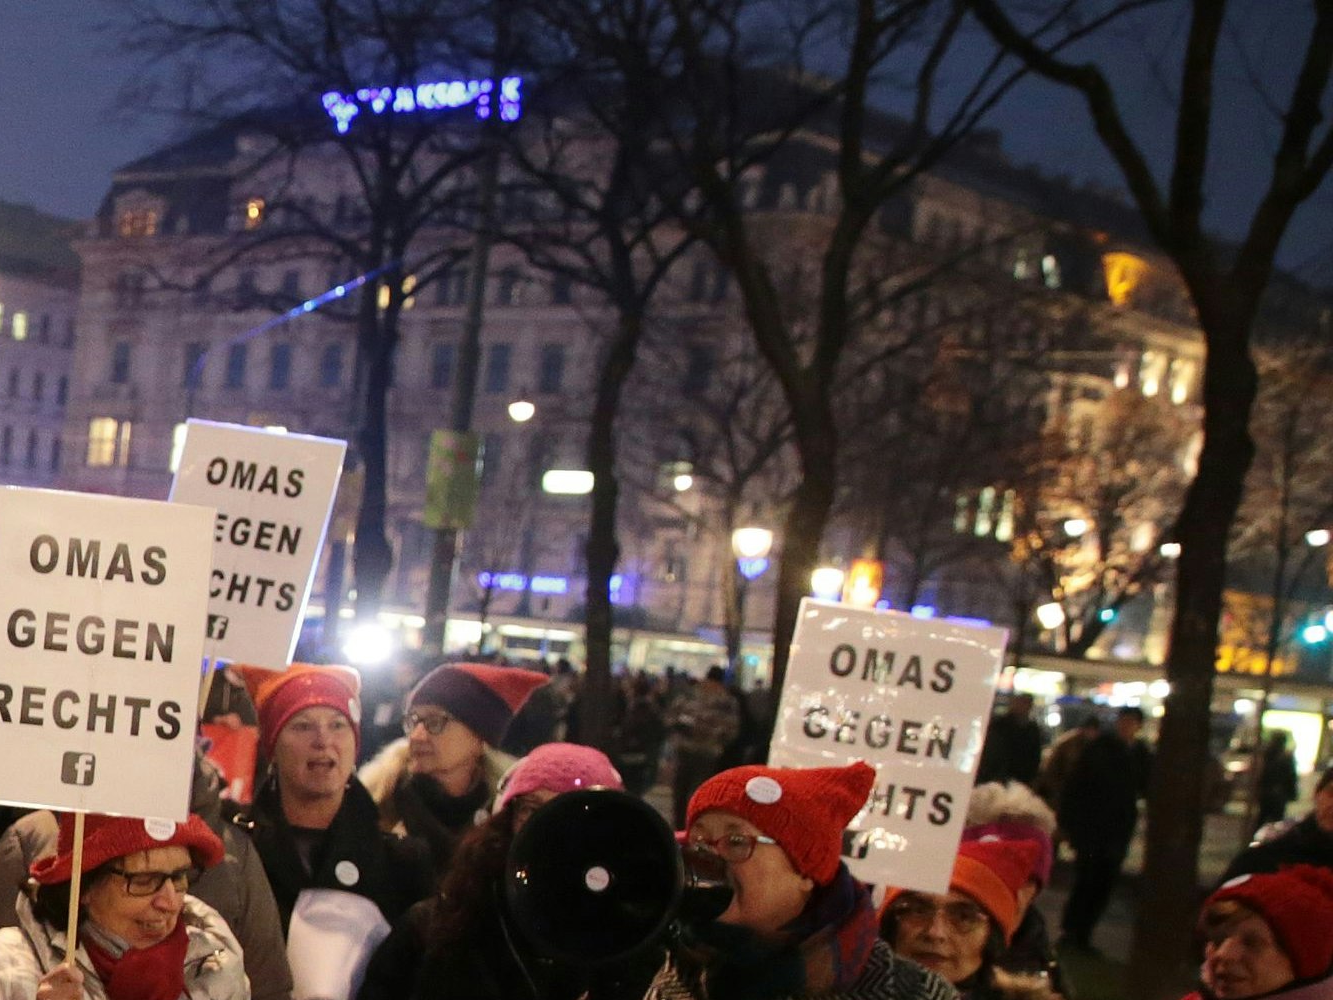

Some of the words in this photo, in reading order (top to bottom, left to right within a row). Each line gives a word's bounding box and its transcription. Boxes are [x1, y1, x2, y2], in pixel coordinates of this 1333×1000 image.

[206, 456, 304, 498] OMAS
[29, 534, 167, 586] OMAS
[7, 608, 175, 663] GEGEN
[830, 643, 955, 694] OMAS
[802, 706, 957, 760] GEGEN
